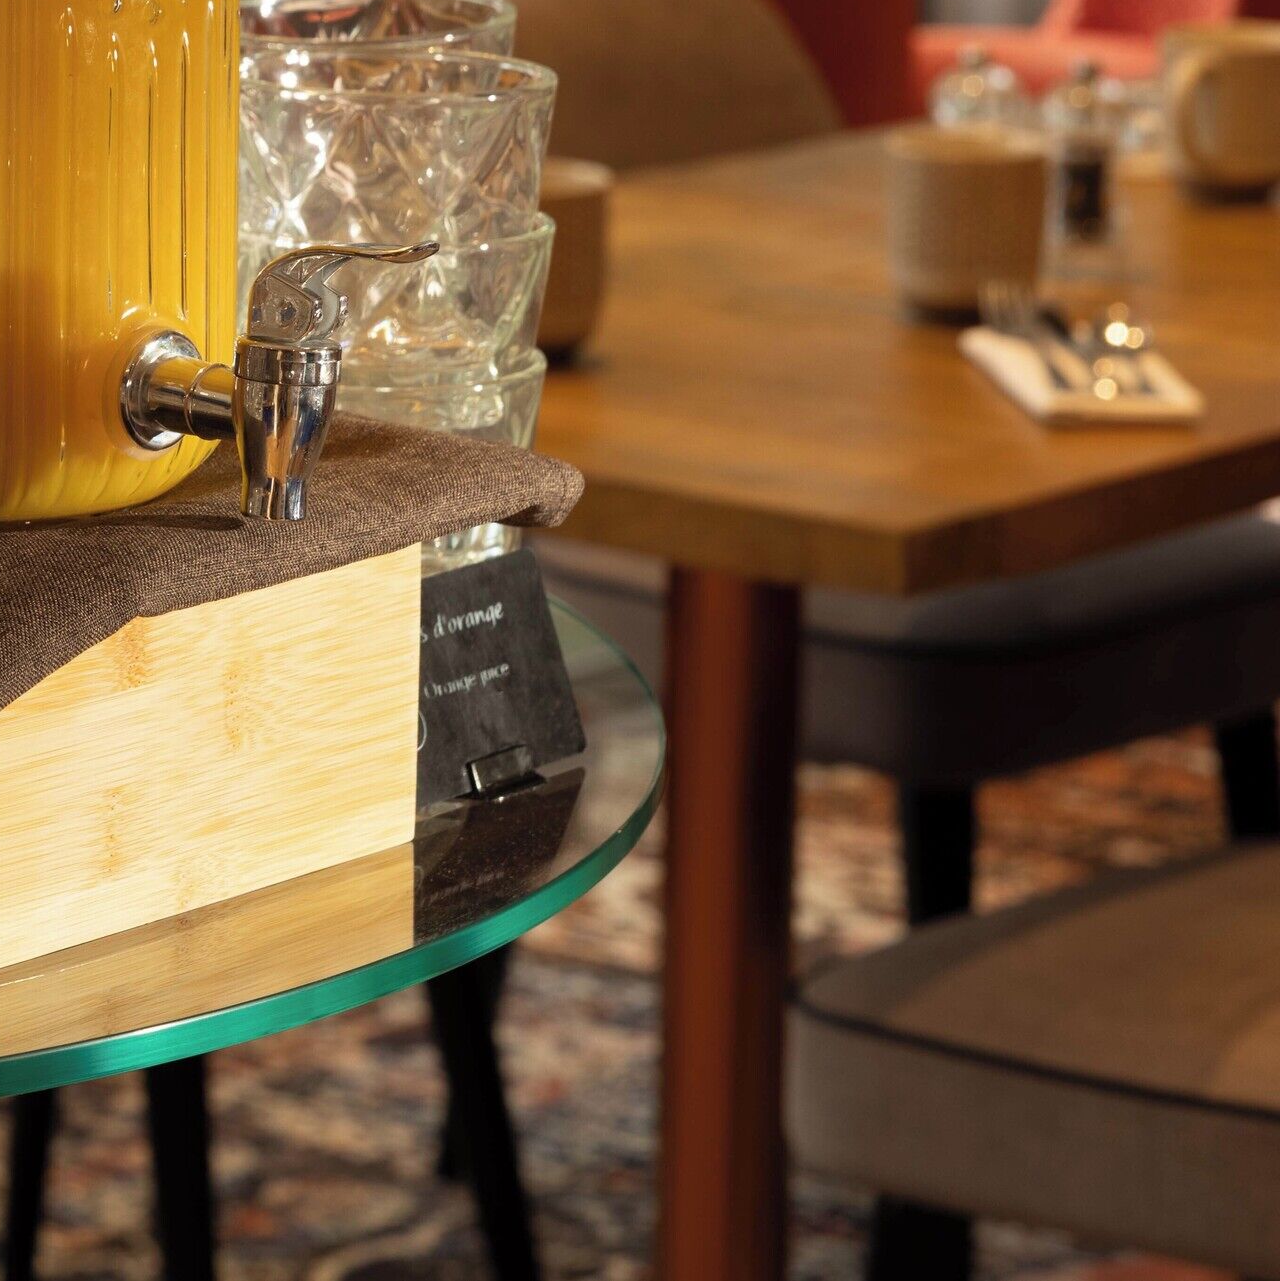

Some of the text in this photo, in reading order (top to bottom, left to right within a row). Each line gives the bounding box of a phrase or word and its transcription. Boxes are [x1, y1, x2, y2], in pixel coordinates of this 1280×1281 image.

[433, 602, 504, 638] d'orange
[423, 662, 509, 699] Orange juice
